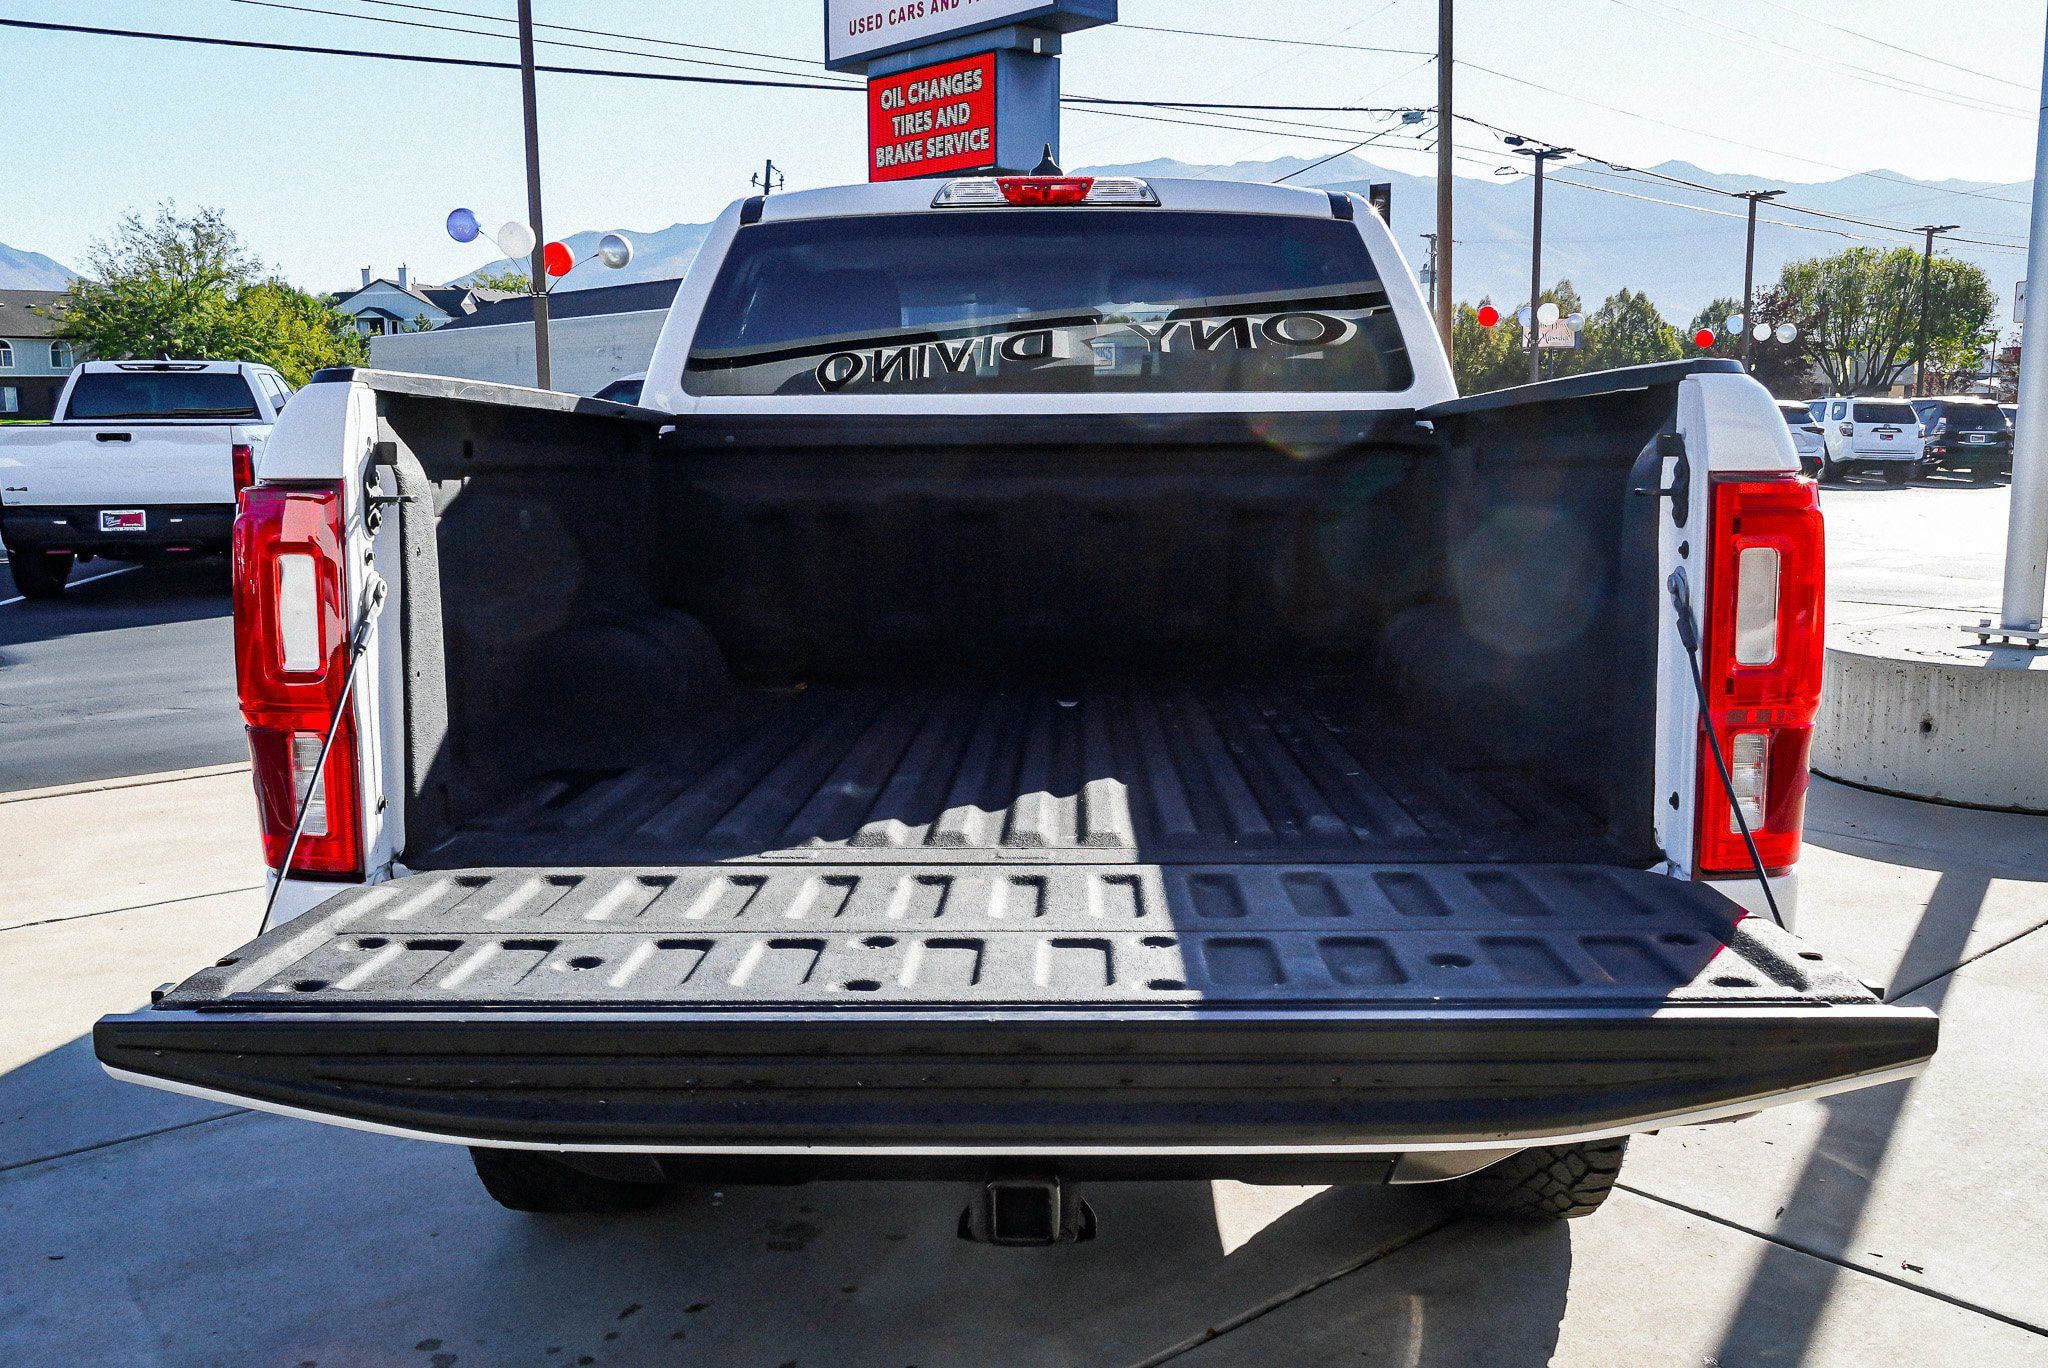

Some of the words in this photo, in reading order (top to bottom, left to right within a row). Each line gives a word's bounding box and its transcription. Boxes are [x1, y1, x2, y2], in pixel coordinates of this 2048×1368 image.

[849, 13, 882, 36] USED
[889, 1, 924, 25] CARS
[880, 86, 906, 110] OIL
[907, 68, 983, 104] CHANGES
[891, 110, 933, 137] TIRES
[935, 102, 971, 129] AND
[876, 140, 924, 168] BRAKE
[925, 126, 990, 158] SERVICE
